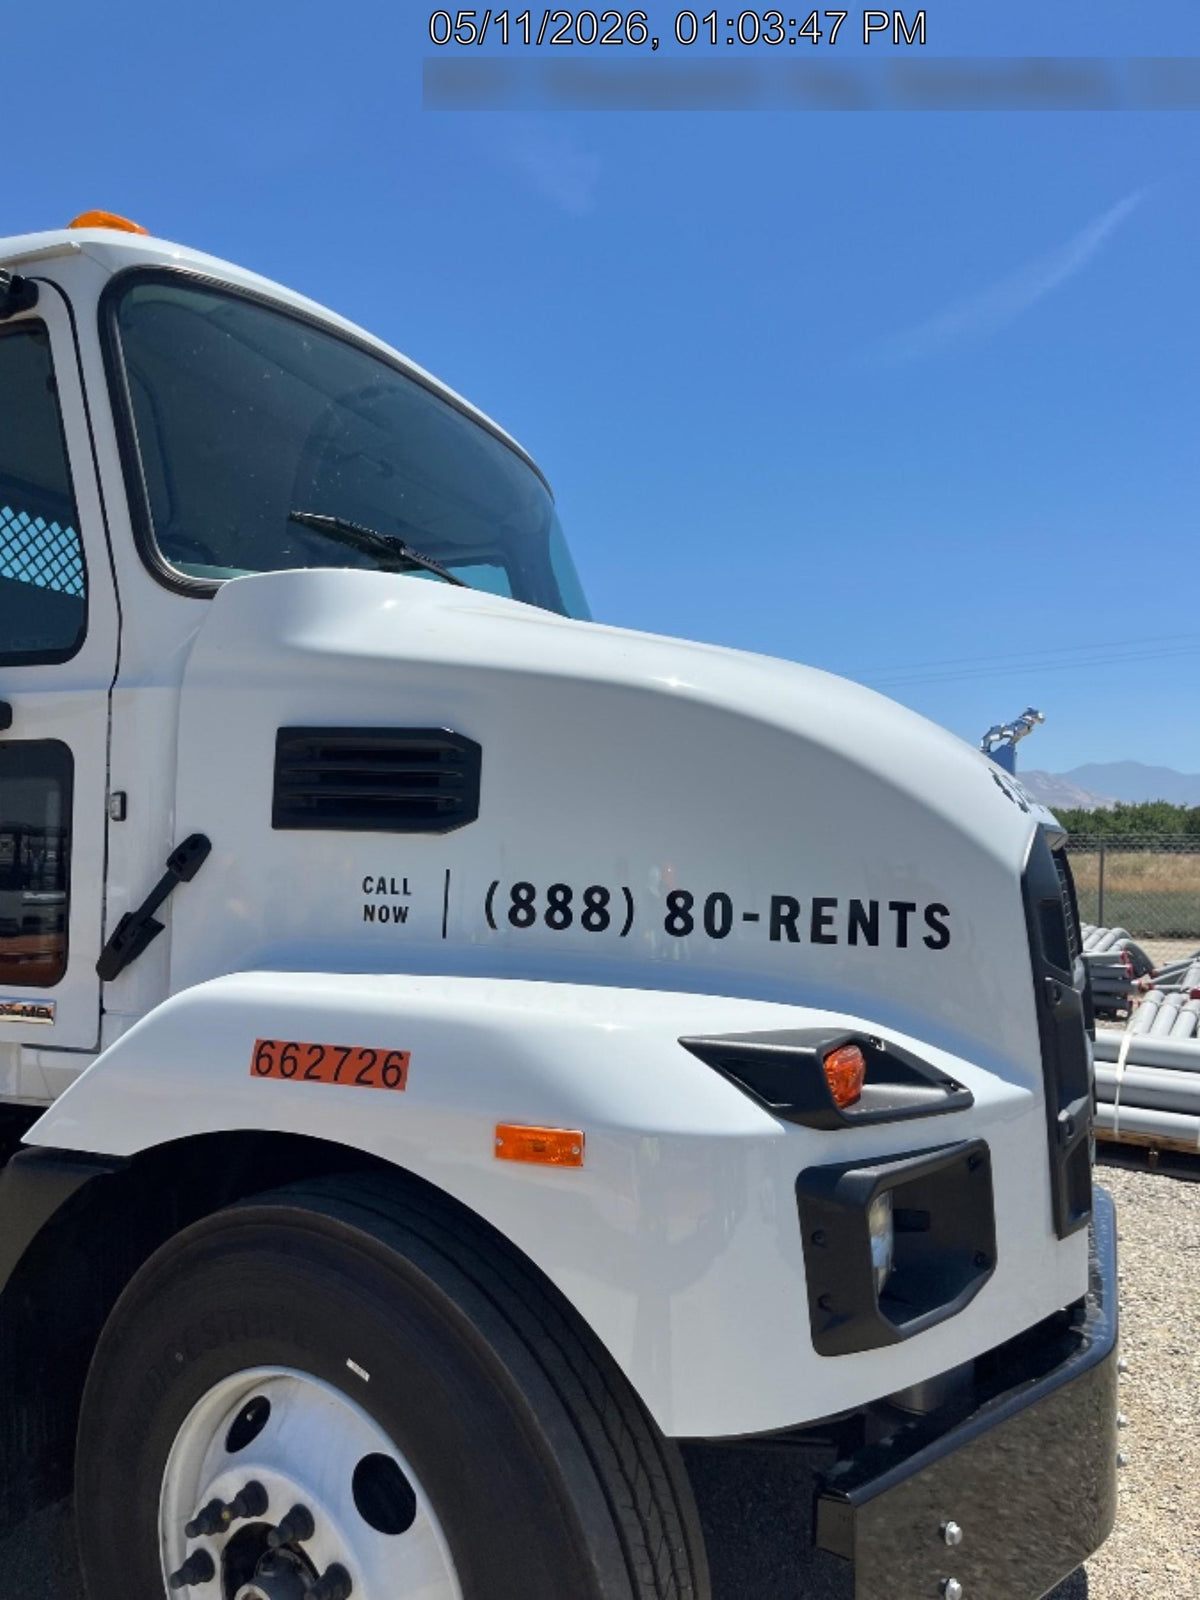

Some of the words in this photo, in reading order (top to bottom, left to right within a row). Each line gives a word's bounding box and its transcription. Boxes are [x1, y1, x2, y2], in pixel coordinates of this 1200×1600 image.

[362, 876, 412, 896] CALL
[363, 904, 409, 925] NOW
[484, 880, 634, 938] (888)
[664, 887, 952, 950] 80-RENTS
[254, 1040, 405, 1088] 662726
